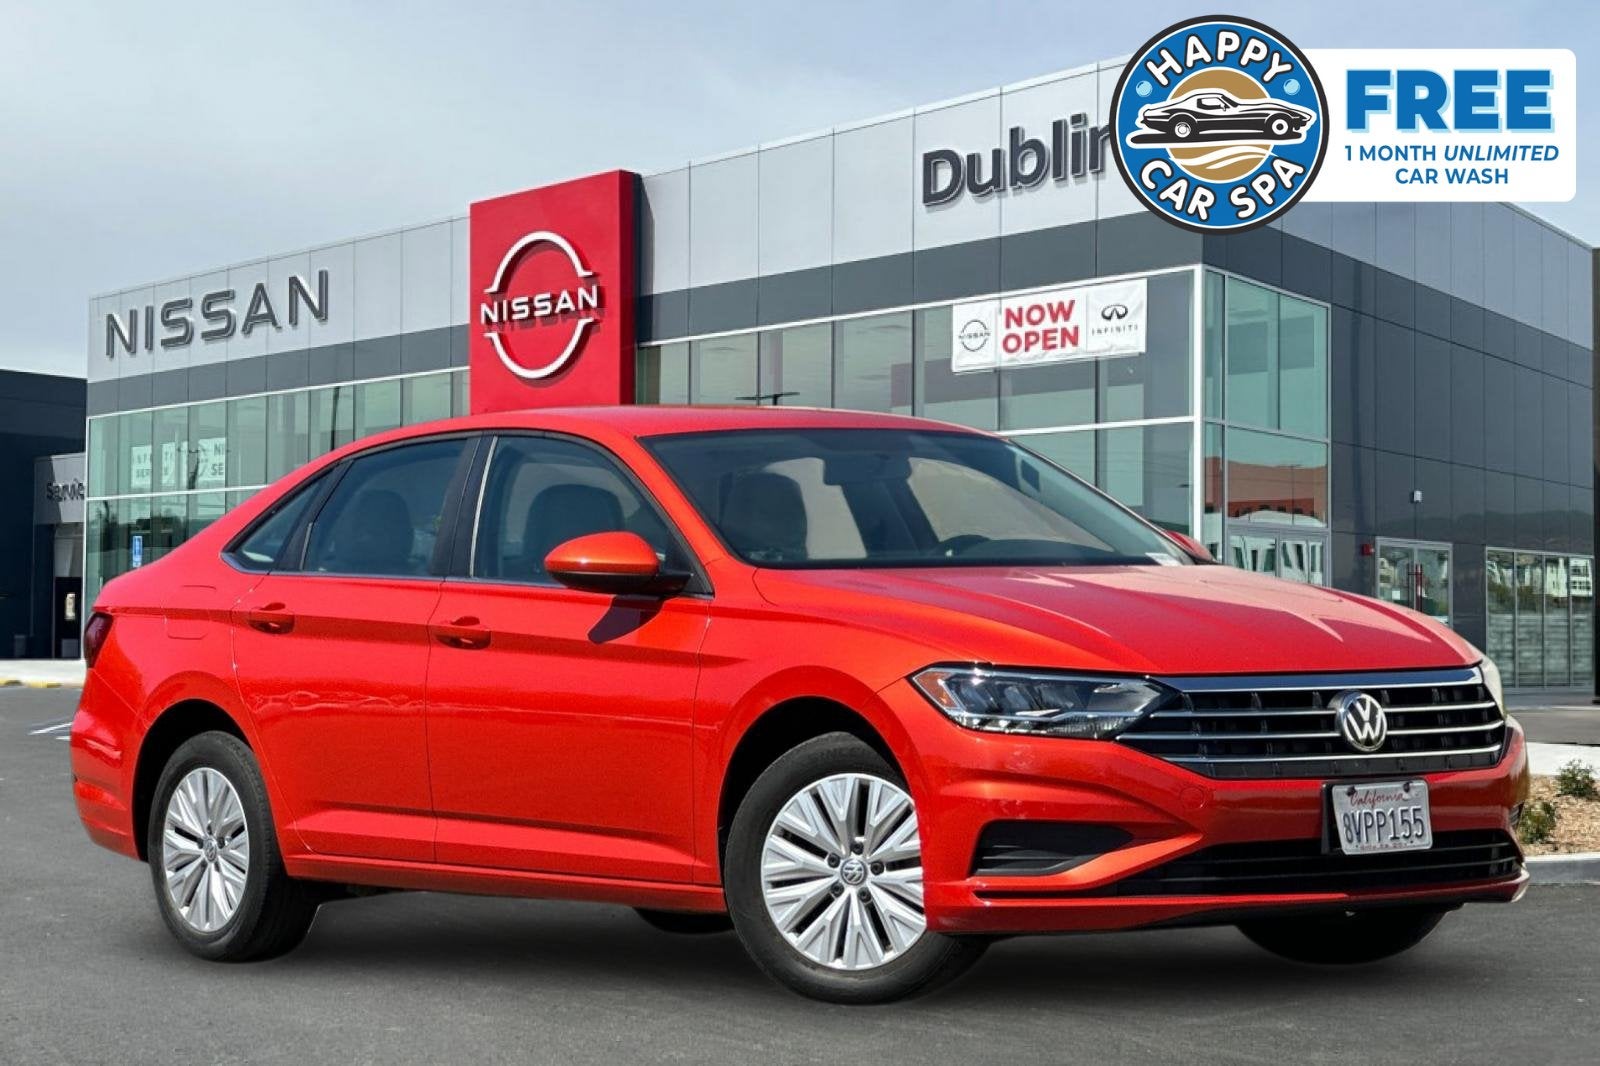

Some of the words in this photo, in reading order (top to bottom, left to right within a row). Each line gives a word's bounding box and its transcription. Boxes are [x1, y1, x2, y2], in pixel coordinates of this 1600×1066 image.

[105, 269, 330, 360] NISSAN
[480, 285, 599, 325] NISSAN
[1005, 299, 1076, 329] NOW
[957, 330, 992, 341] NISSAN
[1002, 325, 1080, 354] OPEN
[1091, 324, 1139, 337] INFINITI
[1350, 788, 1405, 808] California
[1342, 805, 1425, 844] 8VPP155
